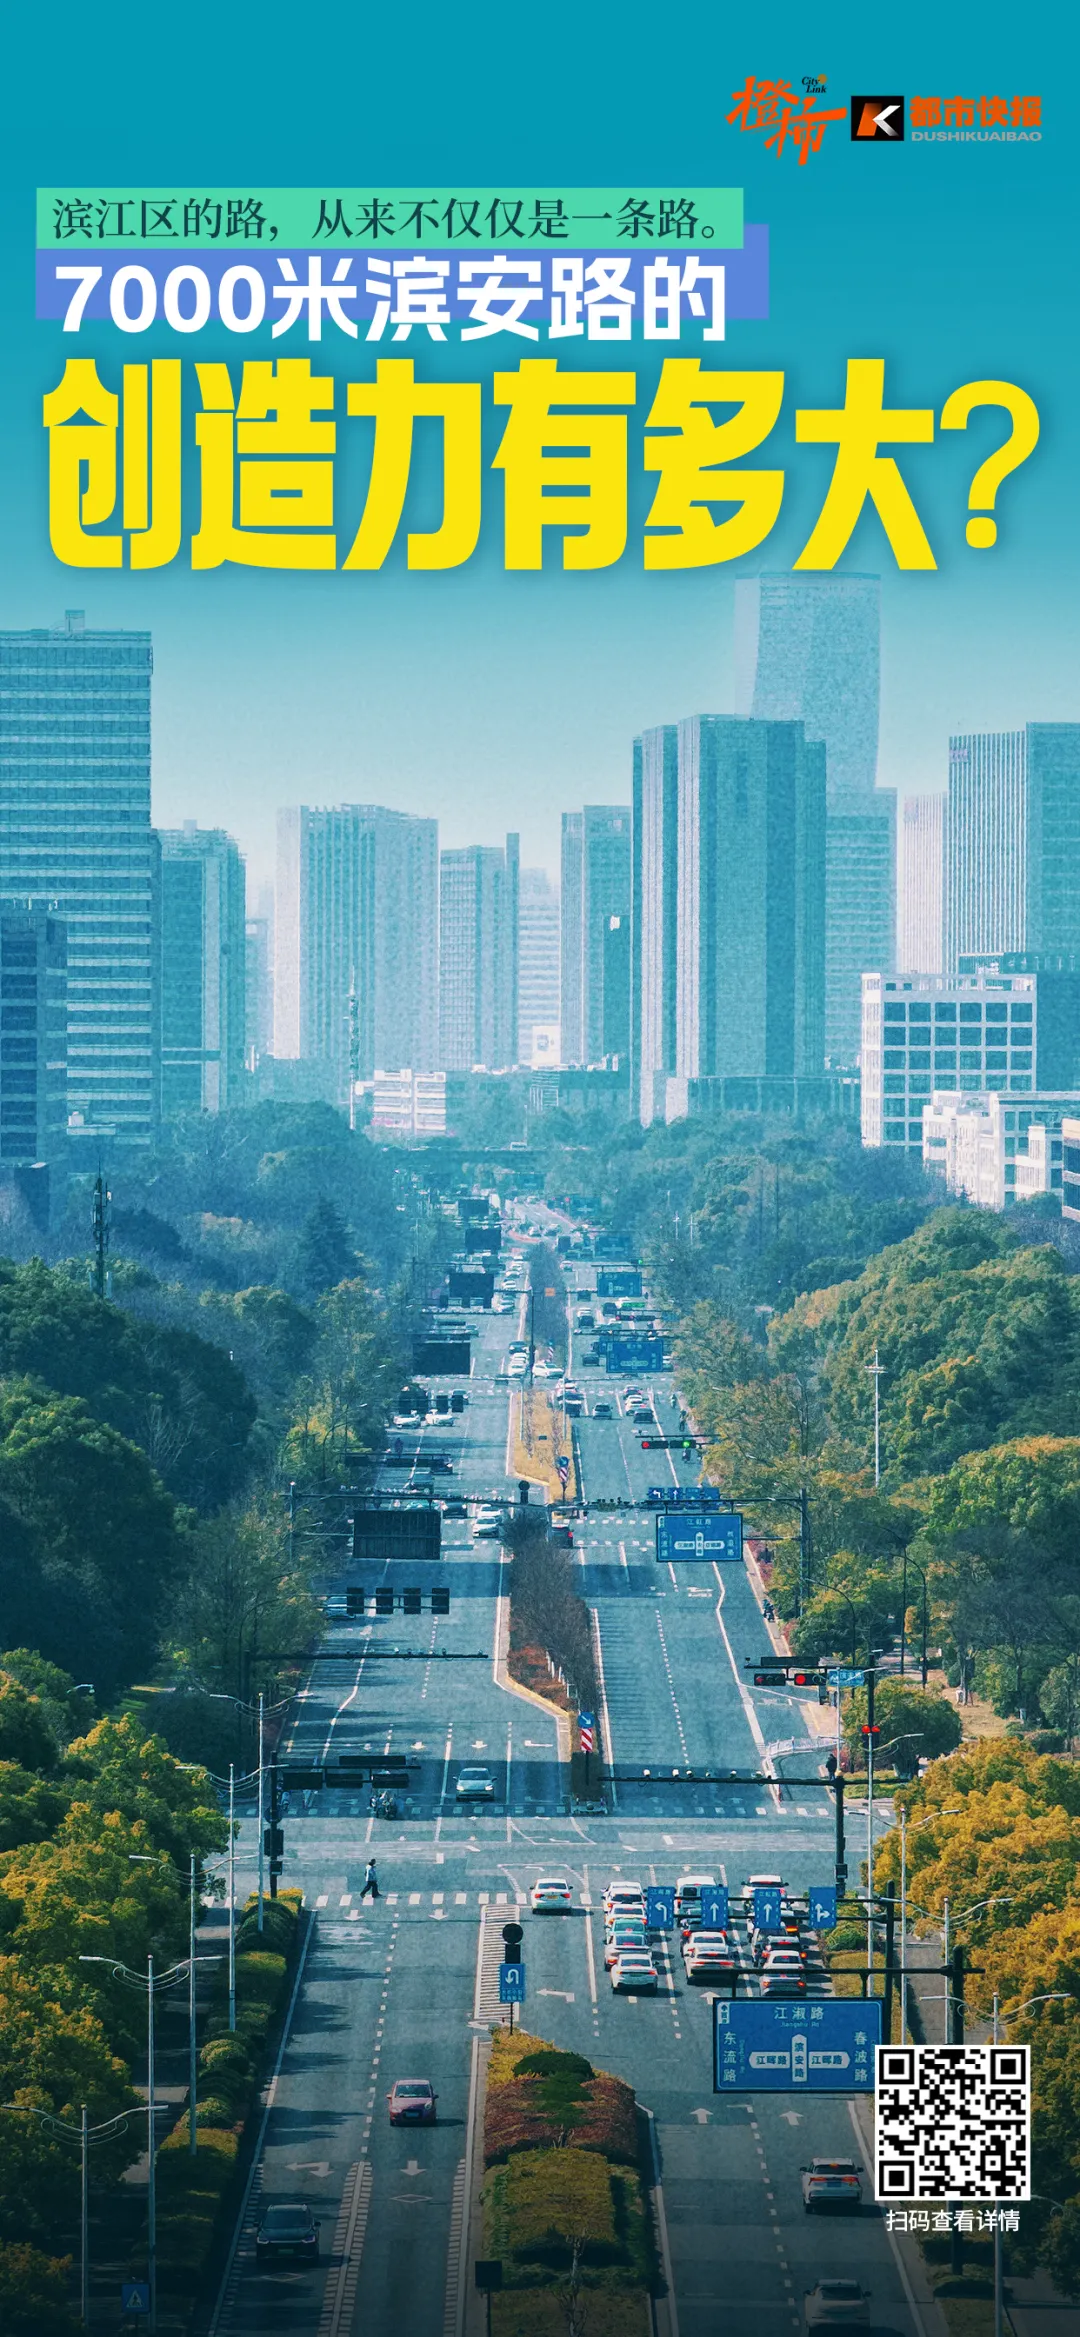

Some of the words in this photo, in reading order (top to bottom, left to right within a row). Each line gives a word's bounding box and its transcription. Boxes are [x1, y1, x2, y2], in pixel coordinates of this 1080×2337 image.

[774, 2006, 825, 2021] 江淑路
[723, 2031, 737, 2083] 东流路
[755, 2055, 788, 2066] 江晖路
[811, 2055, 843, 2066] 江晖路
[853, 2030, 868, 2083] 春波路
